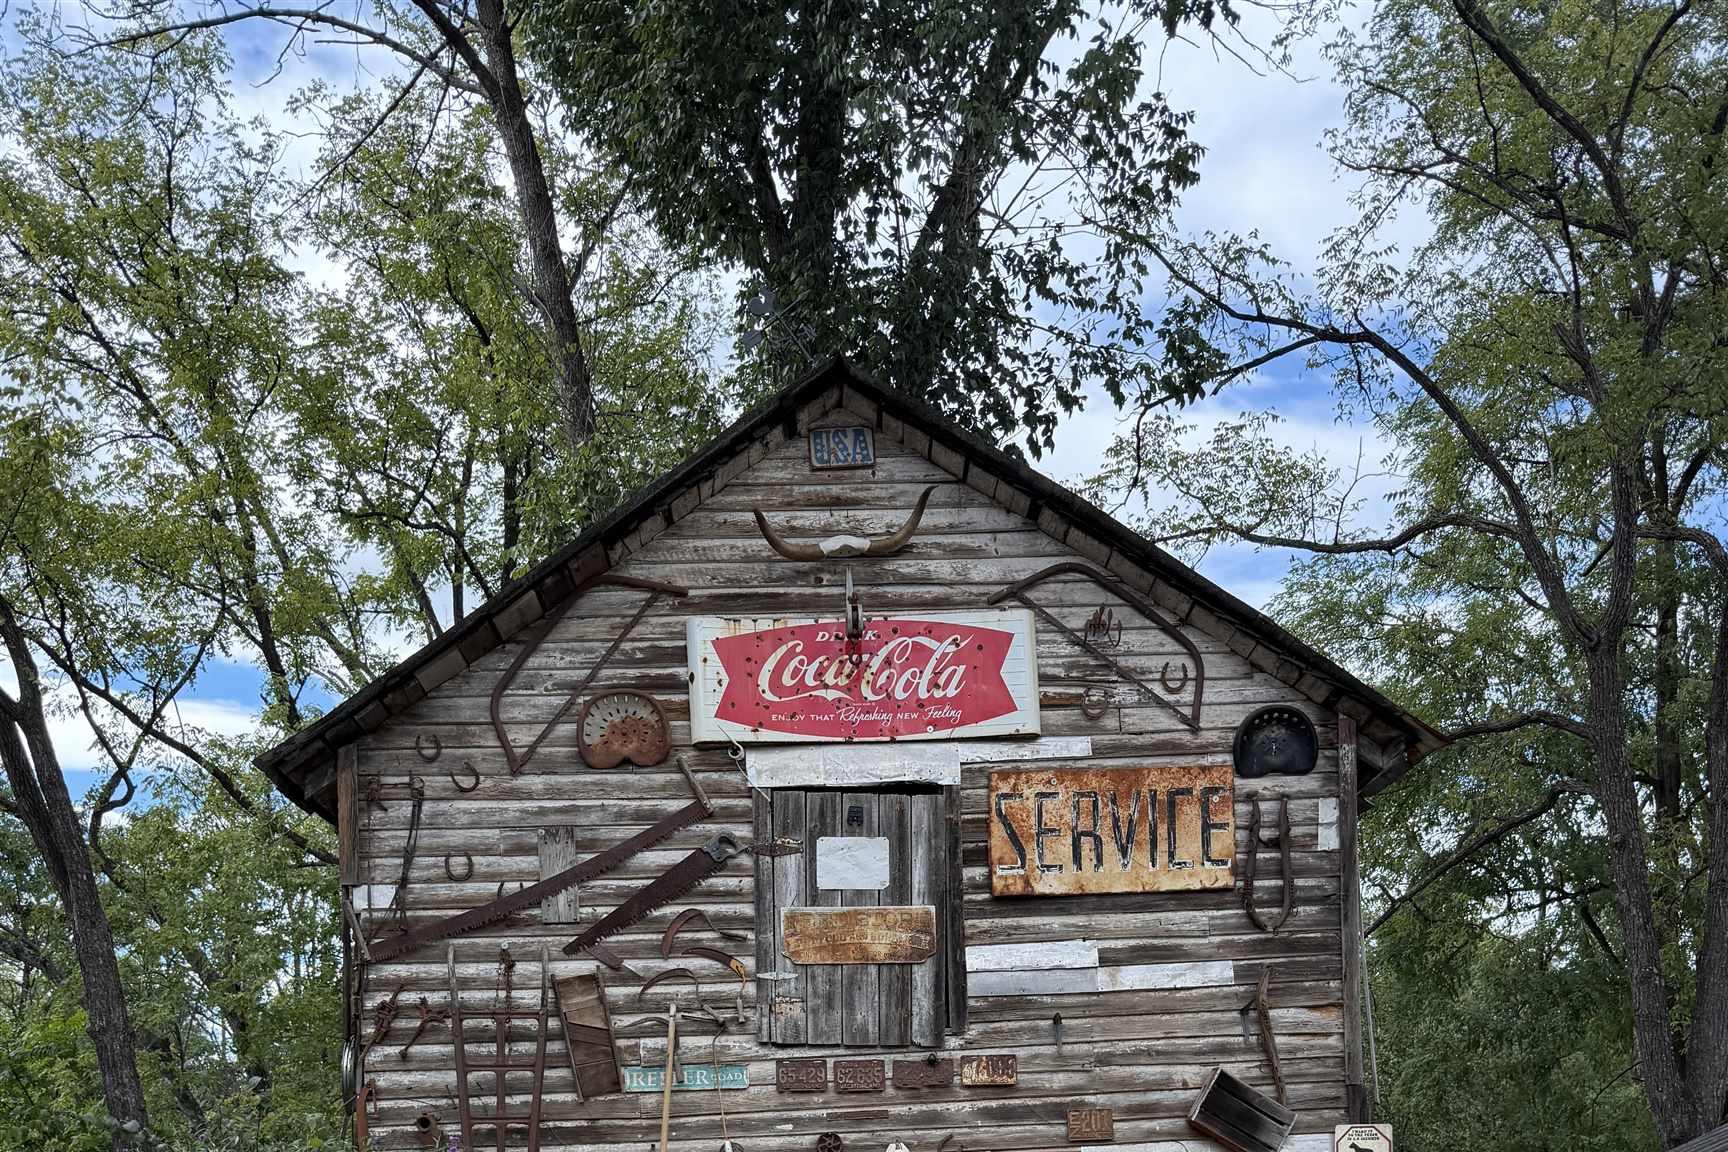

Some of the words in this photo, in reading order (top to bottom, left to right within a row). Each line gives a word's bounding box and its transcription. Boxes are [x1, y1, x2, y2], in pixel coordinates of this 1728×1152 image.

[814, 429, 873, 465] USA
[810, 713, 835, 721] THAT
[836, 706, 893, 727] Refreshing
[896, 711, 919, 720] NEW
[923, 704, 963, 725] Feeling
[995, 784, 1232, 876] SERVICE
